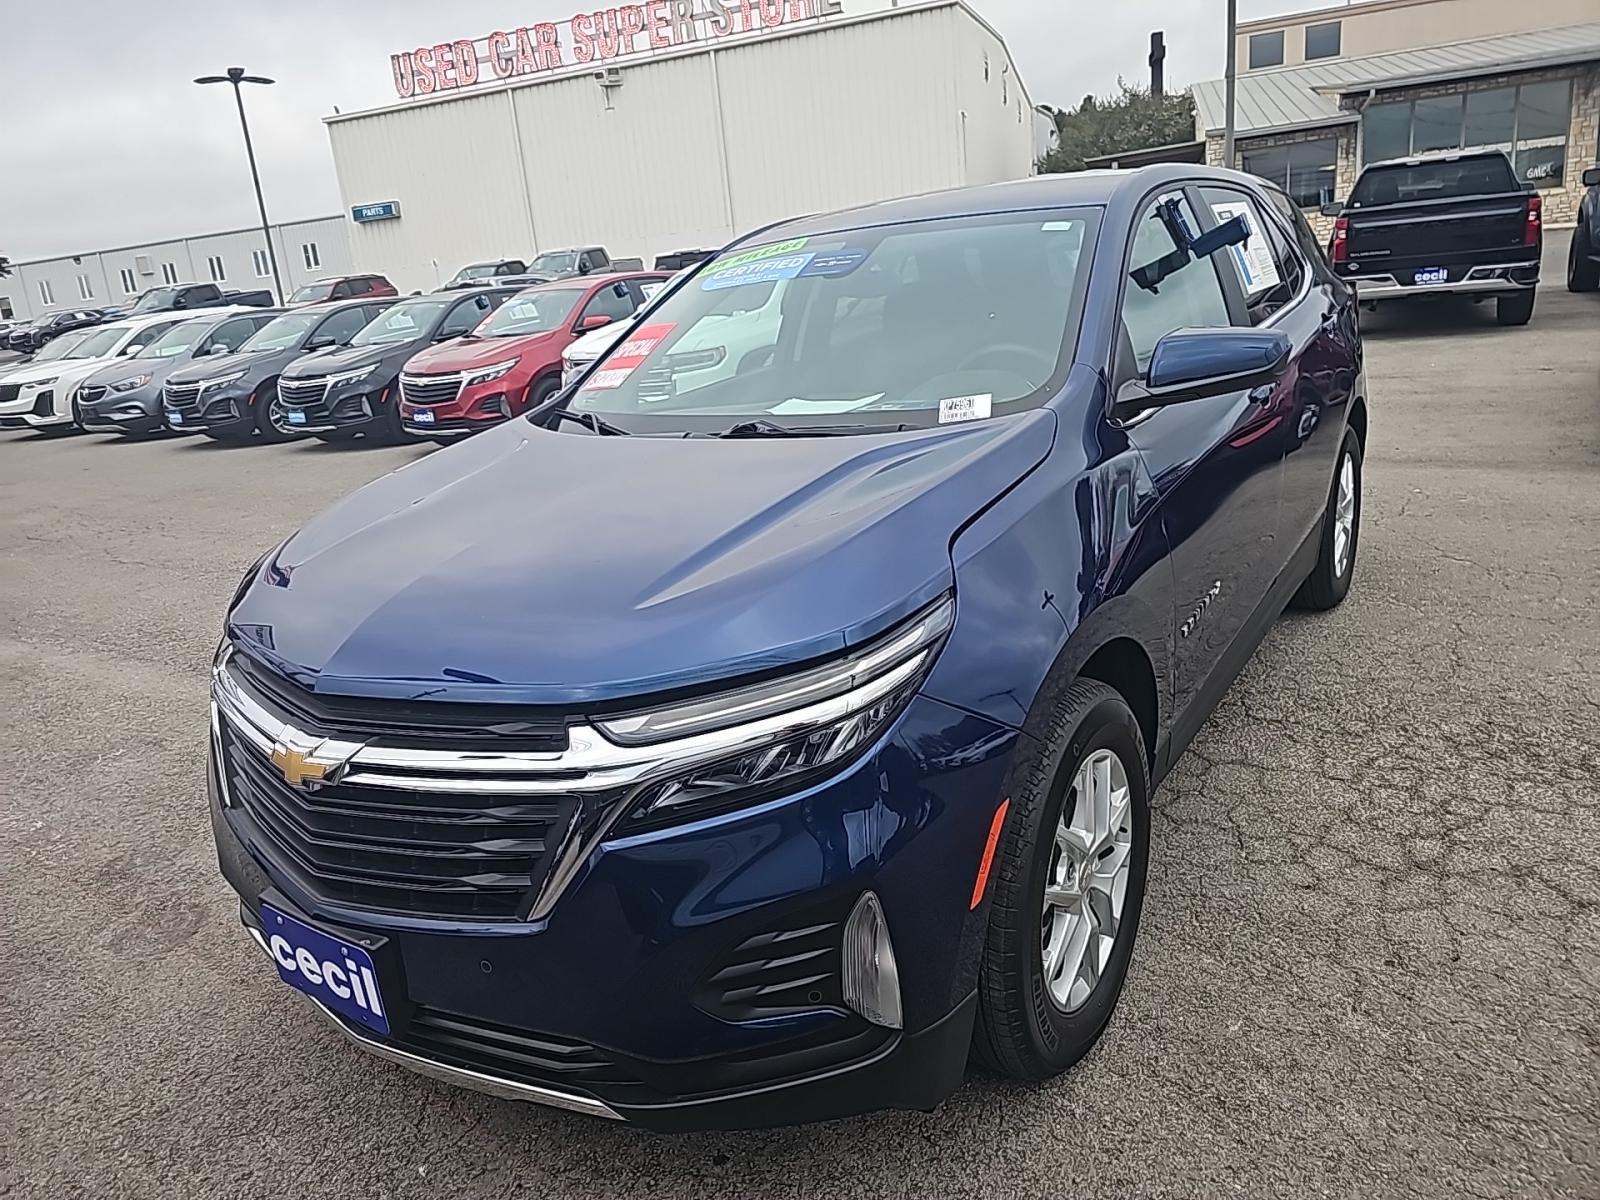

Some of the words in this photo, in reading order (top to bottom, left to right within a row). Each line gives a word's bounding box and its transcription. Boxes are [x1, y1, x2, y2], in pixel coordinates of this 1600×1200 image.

[389, 40, 479, 97] USED
[488, 22, 563, 78] CAR
[571, 0, 697, 63] SUPER
[710, 0, 843, 37] STO
[362, 206, 384, 218] PARTS
[714, 256, 805, 281] CERTIFIED
[270, 934, 382, 1017] cecil
